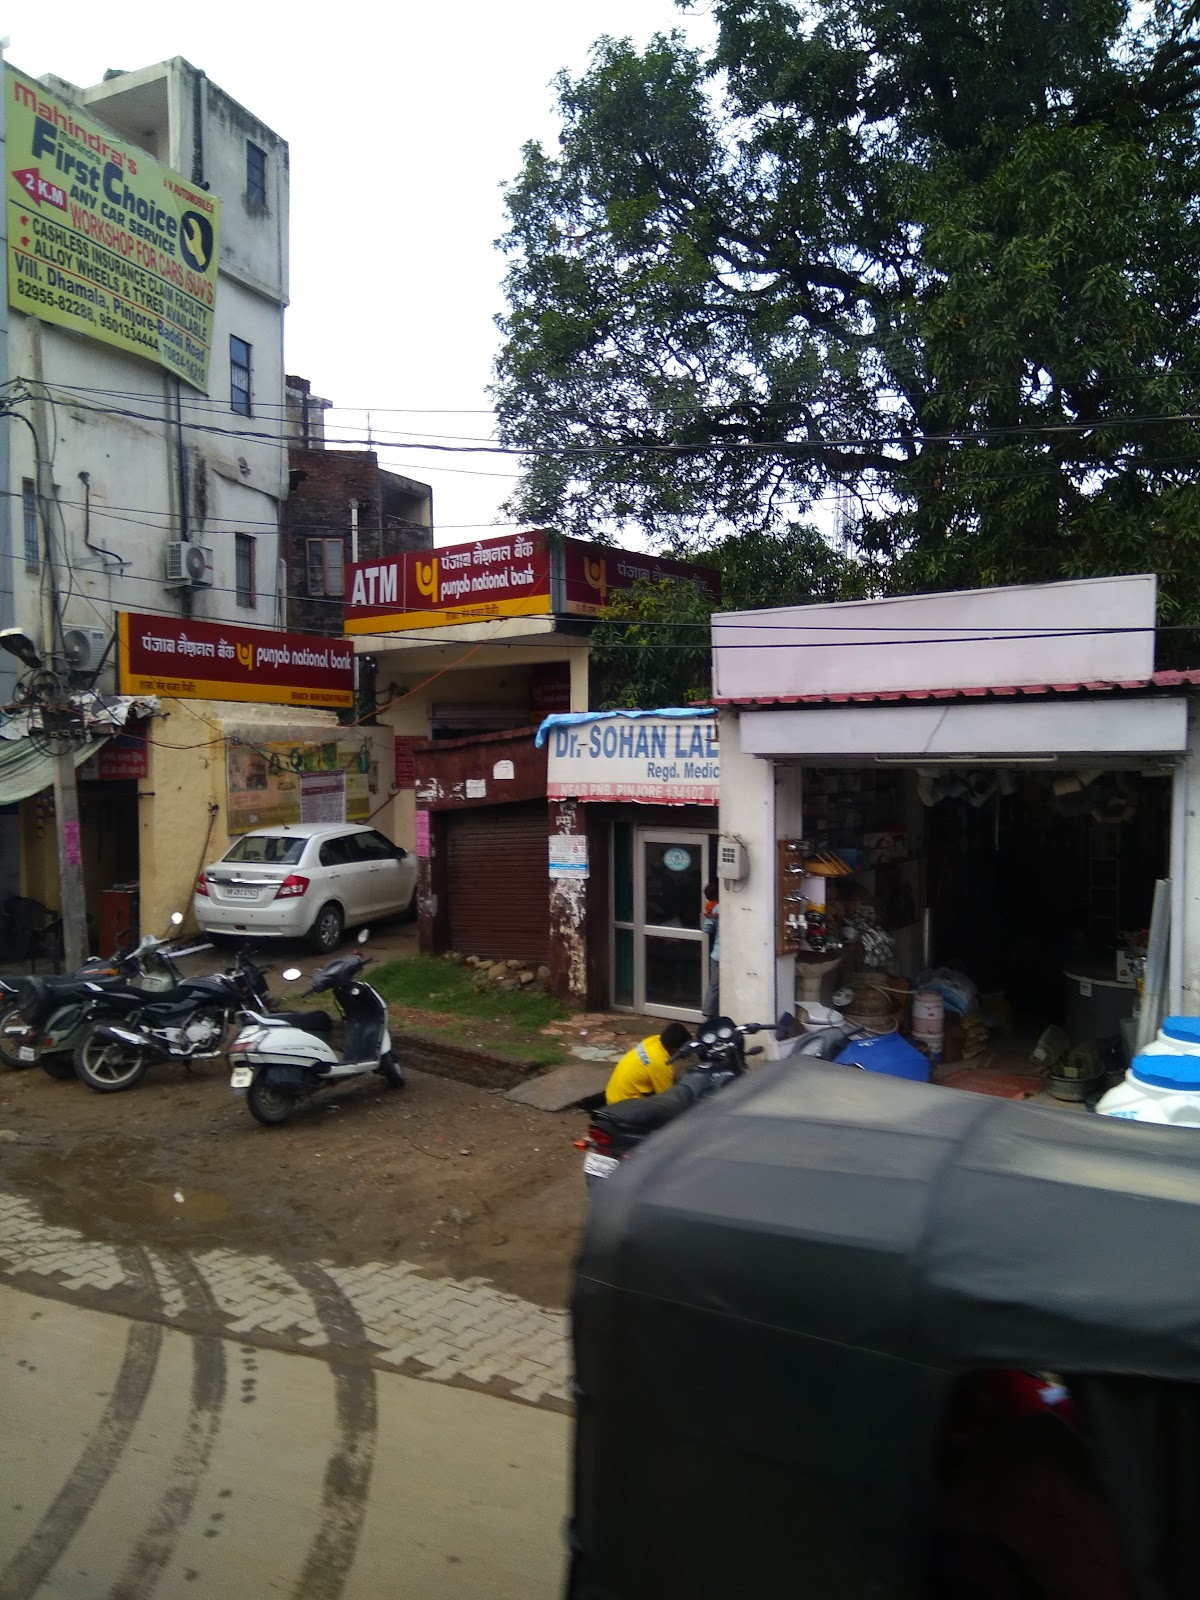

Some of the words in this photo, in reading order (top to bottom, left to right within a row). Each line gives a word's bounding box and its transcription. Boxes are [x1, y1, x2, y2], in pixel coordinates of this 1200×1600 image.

[14, 80, 138, 176] Mahindra's
[24, 173, 36, 191] 2
[32, 115, 101, 193] First
[102, 160, 178, 240] Choice
[69, 184, 98, 210] ANY
[101, 201, 126, 228] CAR
[128, 217, 176, 257] SERVICE
[69, 201, 135, 259] WORKSHOP
[136, 239, 159, 273] FOR
[32, 217, 90, 259] CASHLESS
[91, 246, 147, 290] INSURANCE
[14, 251, 43, 283] Vill.
[46, 266, 110, 316] Dhamala,
[33, 238, 74, 270] ALLOY
[75, 256, 121, 294] WHEELS
[122, 280, 131, 299] &
[132, 285, 165, 317] TYRES
[17, 278, 97, 327] 82955-82288,
[440, 549, 473, 571] पंजाब
[473, 541, 512, 566] नैशनल
[514, 535, 534, 558] बैंक
[616, 560, 651, 581] पंजाब
[351, 563, 399, 607] ATM
[440, 573, 472, 602] punjab
[471, 569, 509, 592] national
[511, 562, 535, 586] bank
[141, 631, 175, 654] पंजाब
[177, 632, 215, 658] नैशनल
[217, 637, 235, 660] बैंक
[256, 643, 291, 669] punjab
[291, 647, 329, 669] national
[330, 649, 352, 670] bank
[589, 725, 666, 759] SOHAN
[674, 725, 719, 758] LAL
[560, 784, 588, 796] NEAR
[616, 785, 663, 799] PINJORE
[647, 762, 680, 782] Regd.
